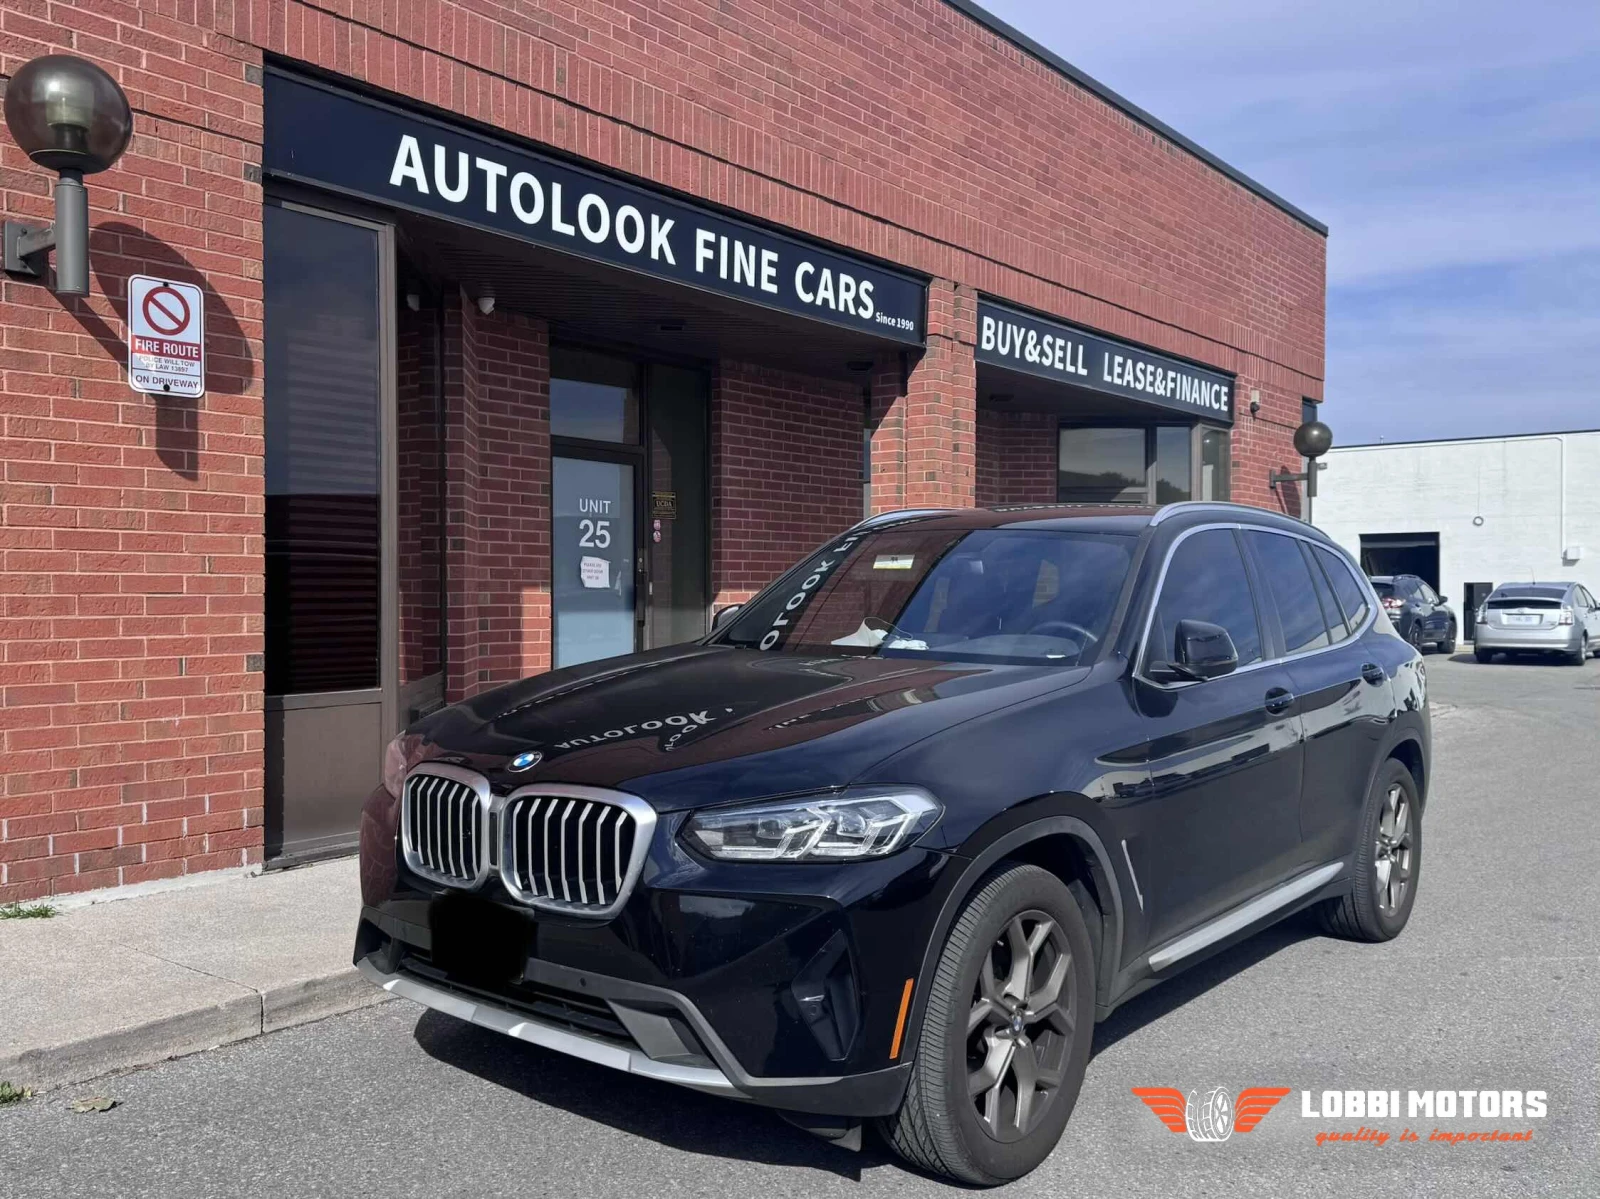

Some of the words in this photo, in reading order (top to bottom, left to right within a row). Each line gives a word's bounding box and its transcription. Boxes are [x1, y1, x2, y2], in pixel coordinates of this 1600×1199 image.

[389, 134, 676, 265] AUTOLOOK
[695, 228, 779, 294] FINE
[794, 261, 874, 319] CARS
[875, 311, 896, 327] Since
[897, 317, 914, 331] 1990
[135, 338, 160, 353] FIRE
[162, 342, 199, 358] ROUTE
[155, 362, 169, 370] LAW
[981, 315, 1088, 376] BUY&SELL
[1103, 351, 1229, 412] LEASE&FINANCE
[135, 374, 150, 384] ON
[152, 376, 199, 388] DRIVEWAY
[579, 498, 611, 514] UNIT
[579, 519, 611, 549] 25
